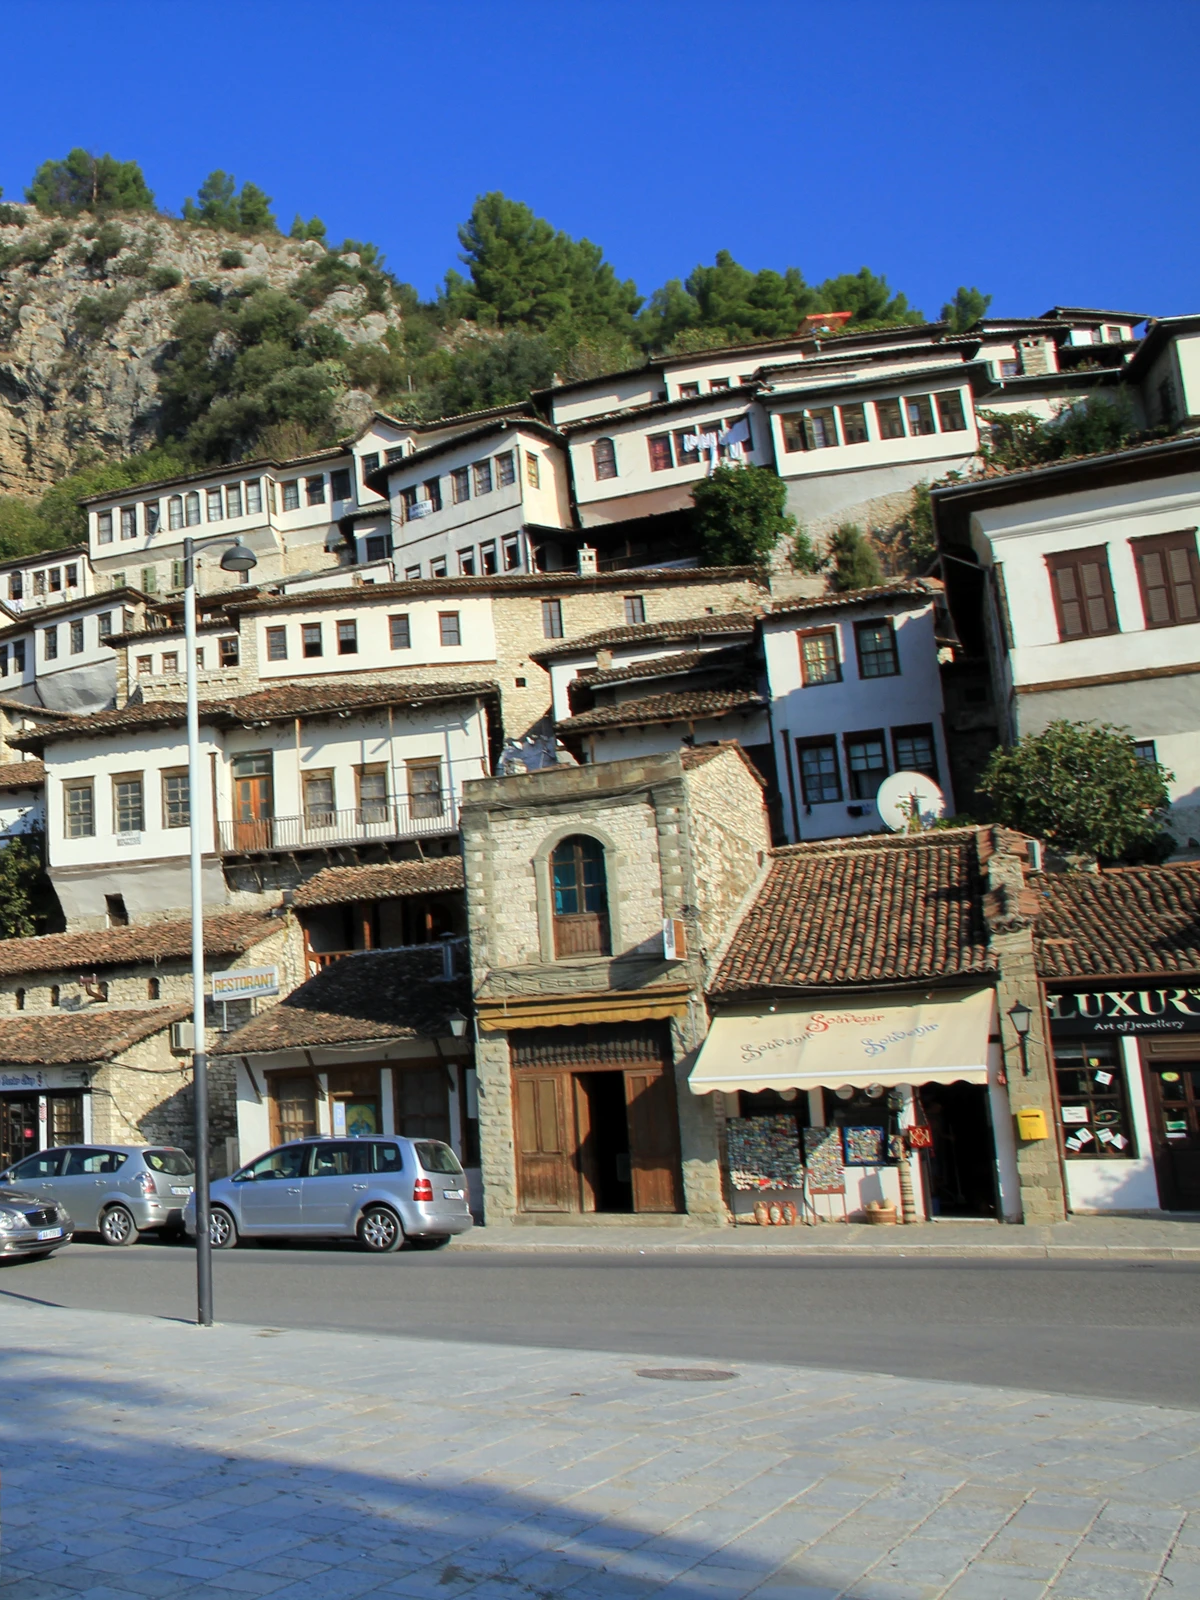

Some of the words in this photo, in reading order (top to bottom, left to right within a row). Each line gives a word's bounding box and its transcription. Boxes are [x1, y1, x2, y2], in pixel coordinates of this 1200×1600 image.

[215, 973, 274, 993] RESTORANT
[805, 1013, 884, 1032] Souvenir
[1094, 1022, 1115, 1030] Art
[1116, 1021, 1130, 1031] of
[1129, 1019, 1185, 1030] Jewellery
[740, 1032, 814, 1063] Souvenir
[861, 1024, 939, 1057] Souvenir
